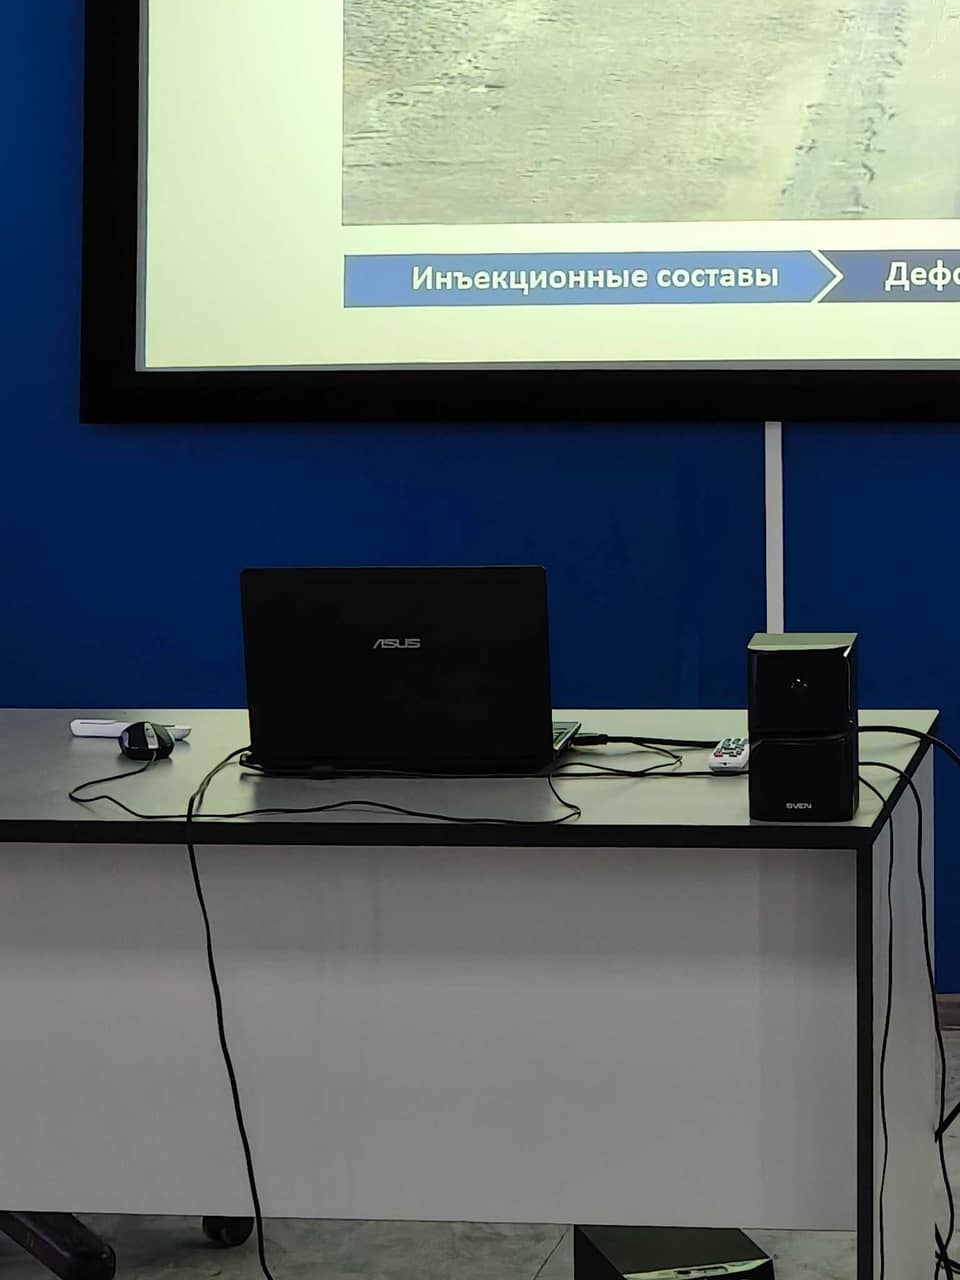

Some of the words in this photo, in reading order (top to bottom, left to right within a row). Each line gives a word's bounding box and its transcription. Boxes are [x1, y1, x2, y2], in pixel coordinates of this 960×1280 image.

[411, 264, 648, 295] Инъекционные
[656, 266, 780, 289] составы
[373, 638, 421, 649] ASUS
